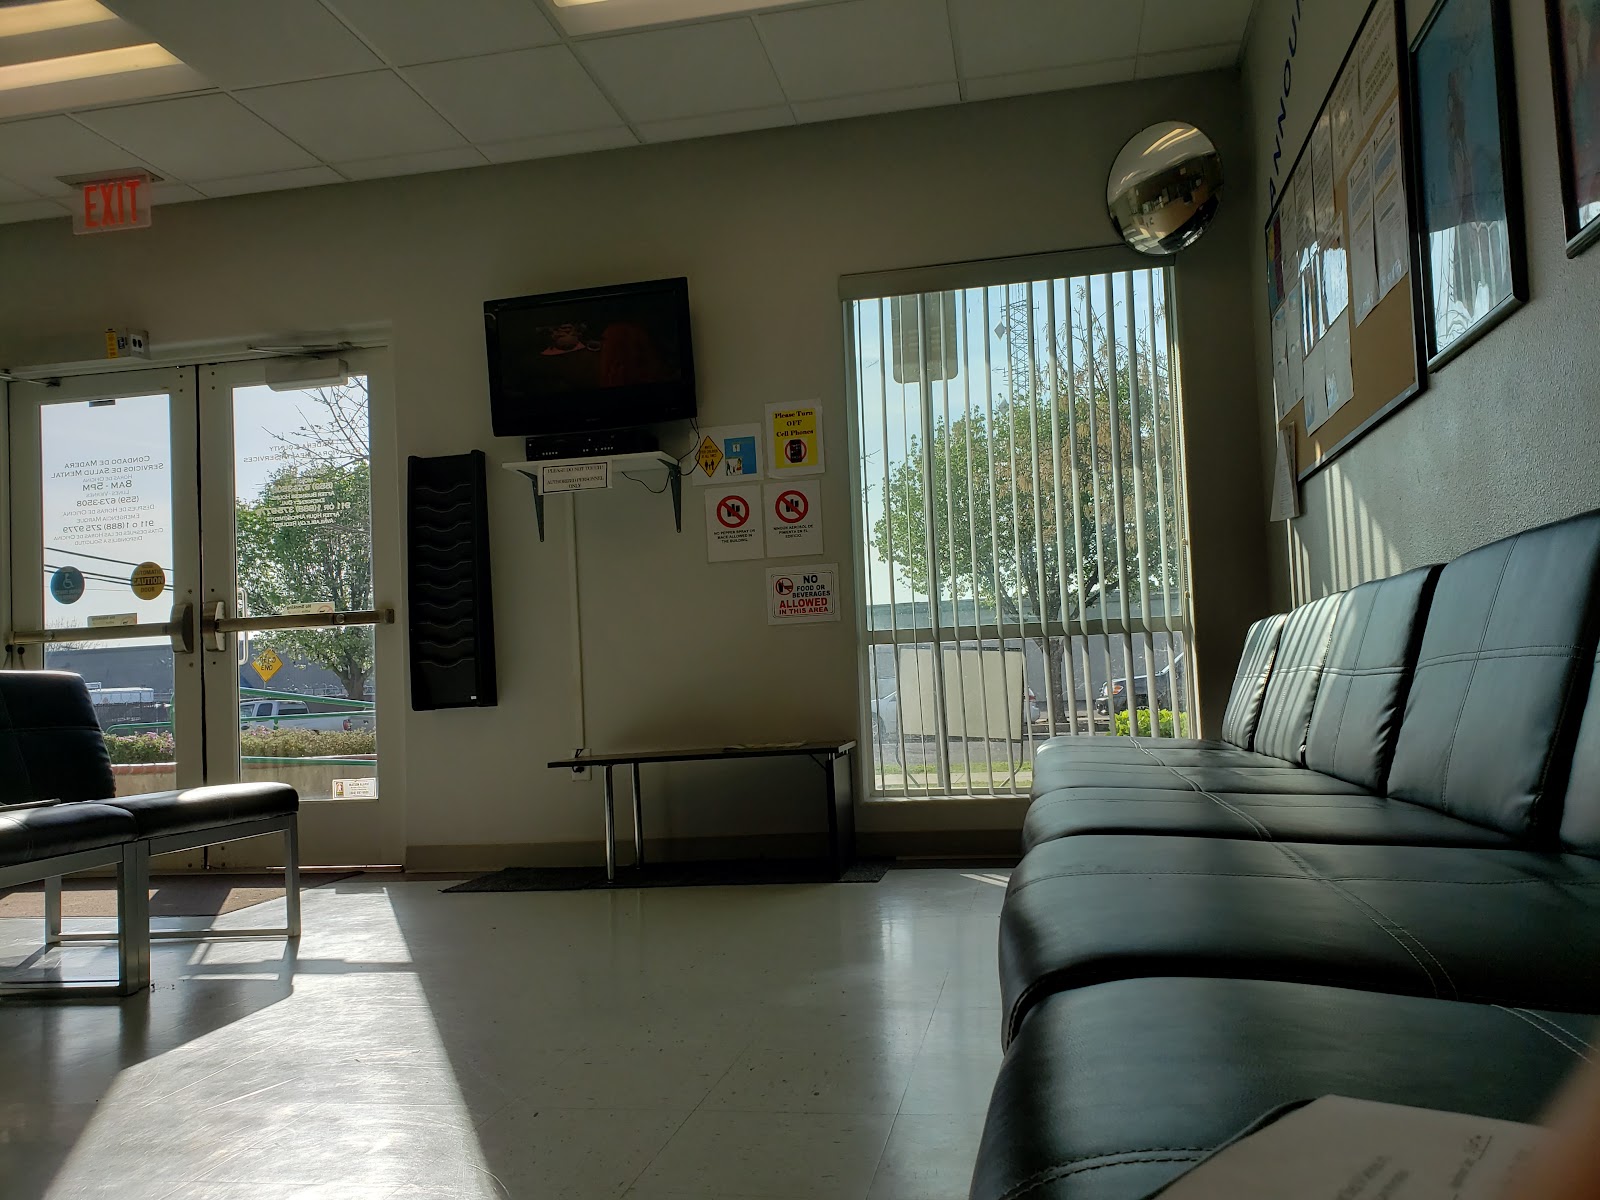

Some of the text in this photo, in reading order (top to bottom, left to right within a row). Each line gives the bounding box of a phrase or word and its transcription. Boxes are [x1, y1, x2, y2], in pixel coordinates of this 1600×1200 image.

[84, 180, 140, 228] EXIT
[132, 576, 164, 585] CAUTION
[803, 575, 818, 584] NO
[780, 597, 828, 608] ALLOWED
